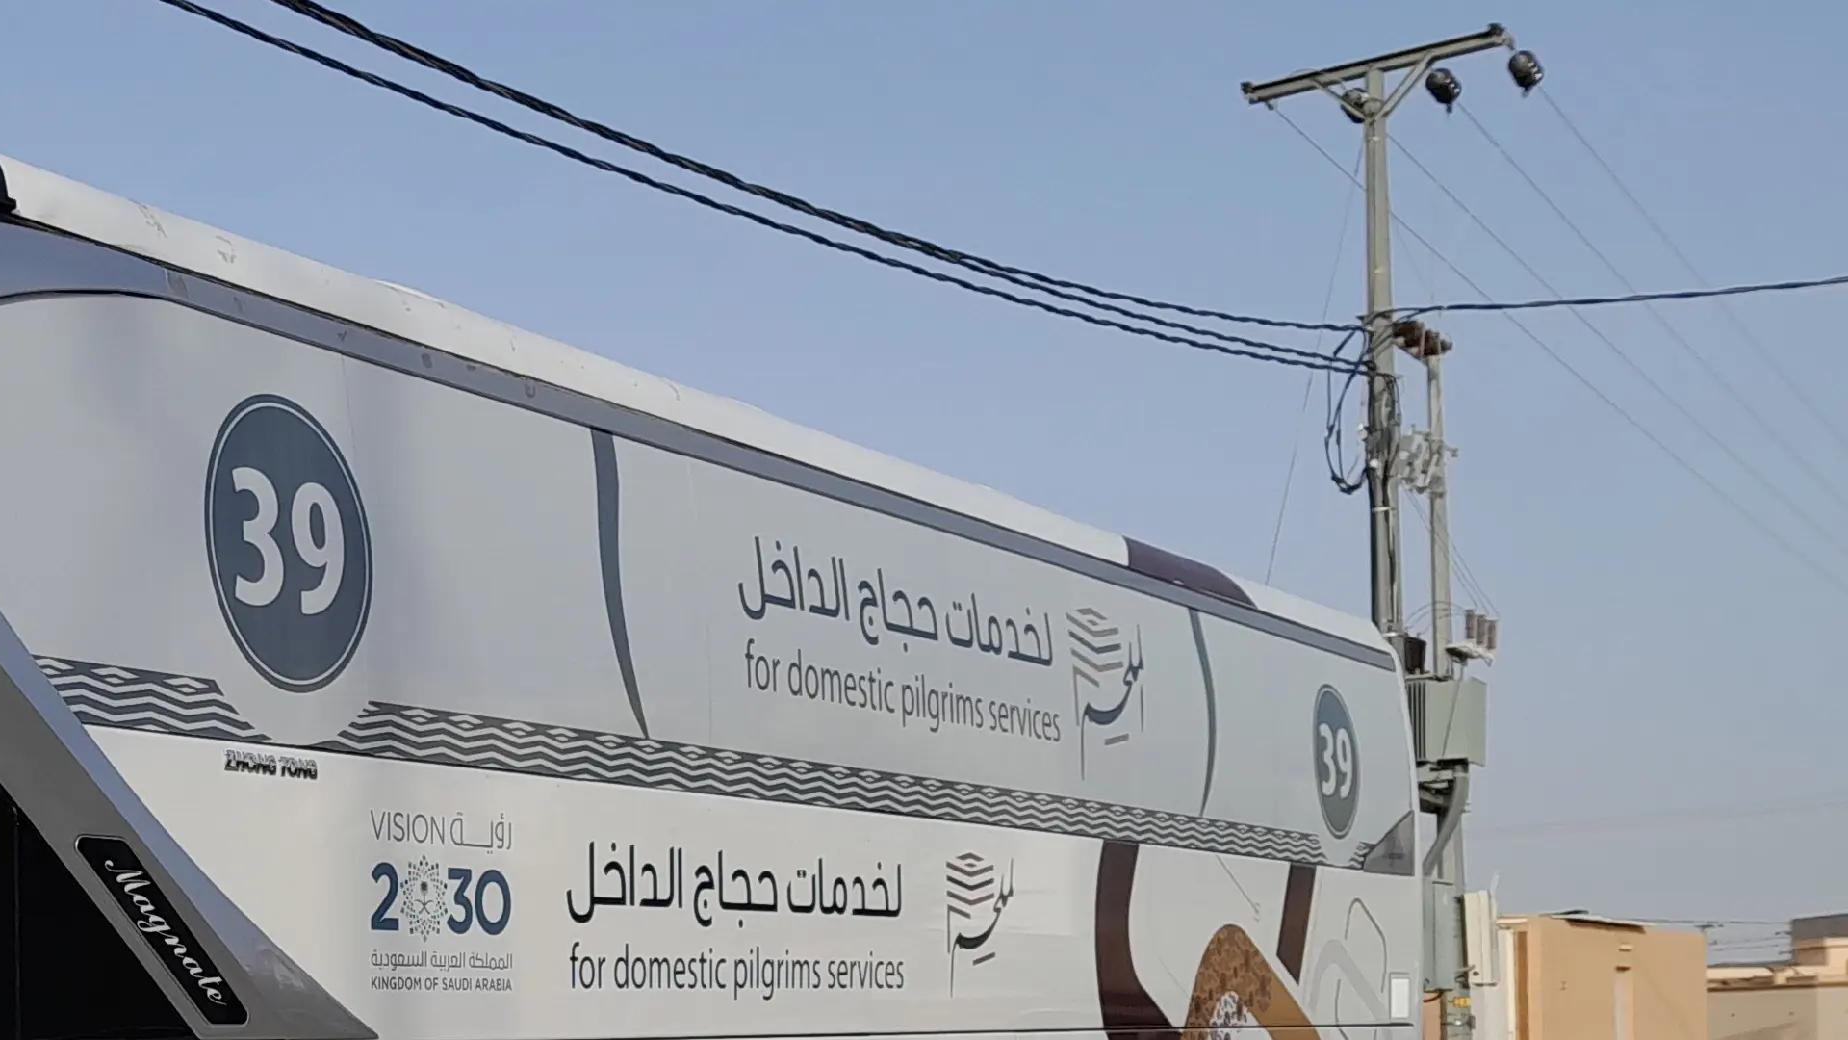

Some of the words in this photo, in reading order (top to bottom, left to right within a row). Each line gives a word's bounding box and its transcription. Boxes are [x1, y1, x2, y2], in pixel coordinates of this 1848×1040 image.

[232, 466, 345, 615] 39
[738, 536, 850, 620] الداخل
[858, 568, 938, 652] حجاج
[946, 592, 1053, 667] لخدمات
[745, 638, 780, 692] for
[788, 649, 895, 714] domestic
[902, 674, 984, 733] pilgrims
[989, 699, 1061, 742] services
[1319, 722, 1353, 800] 39
[370, 809, 445, 845] VISION
[449, 811, 512, 854] رؤية
[566, 841, 682, 923] الداخل
[693, 849, 778, 928] حجاج
[787, 857, 902, 918] لخدمات
[104, 859, 227, 1006] Magnate
[569, 941, 606, 989] for
[613, 943, 727, 989] domestic
[732, 946, 821, 1001] pilgrims
[827, 950, 905, 989] services
[371, 976, 422, 991] KINGDOM
[424, 976, 439, 991] OF
[442, 977, 473, 992] SAUDI
[474, 977, 513, 992] ARABIA
